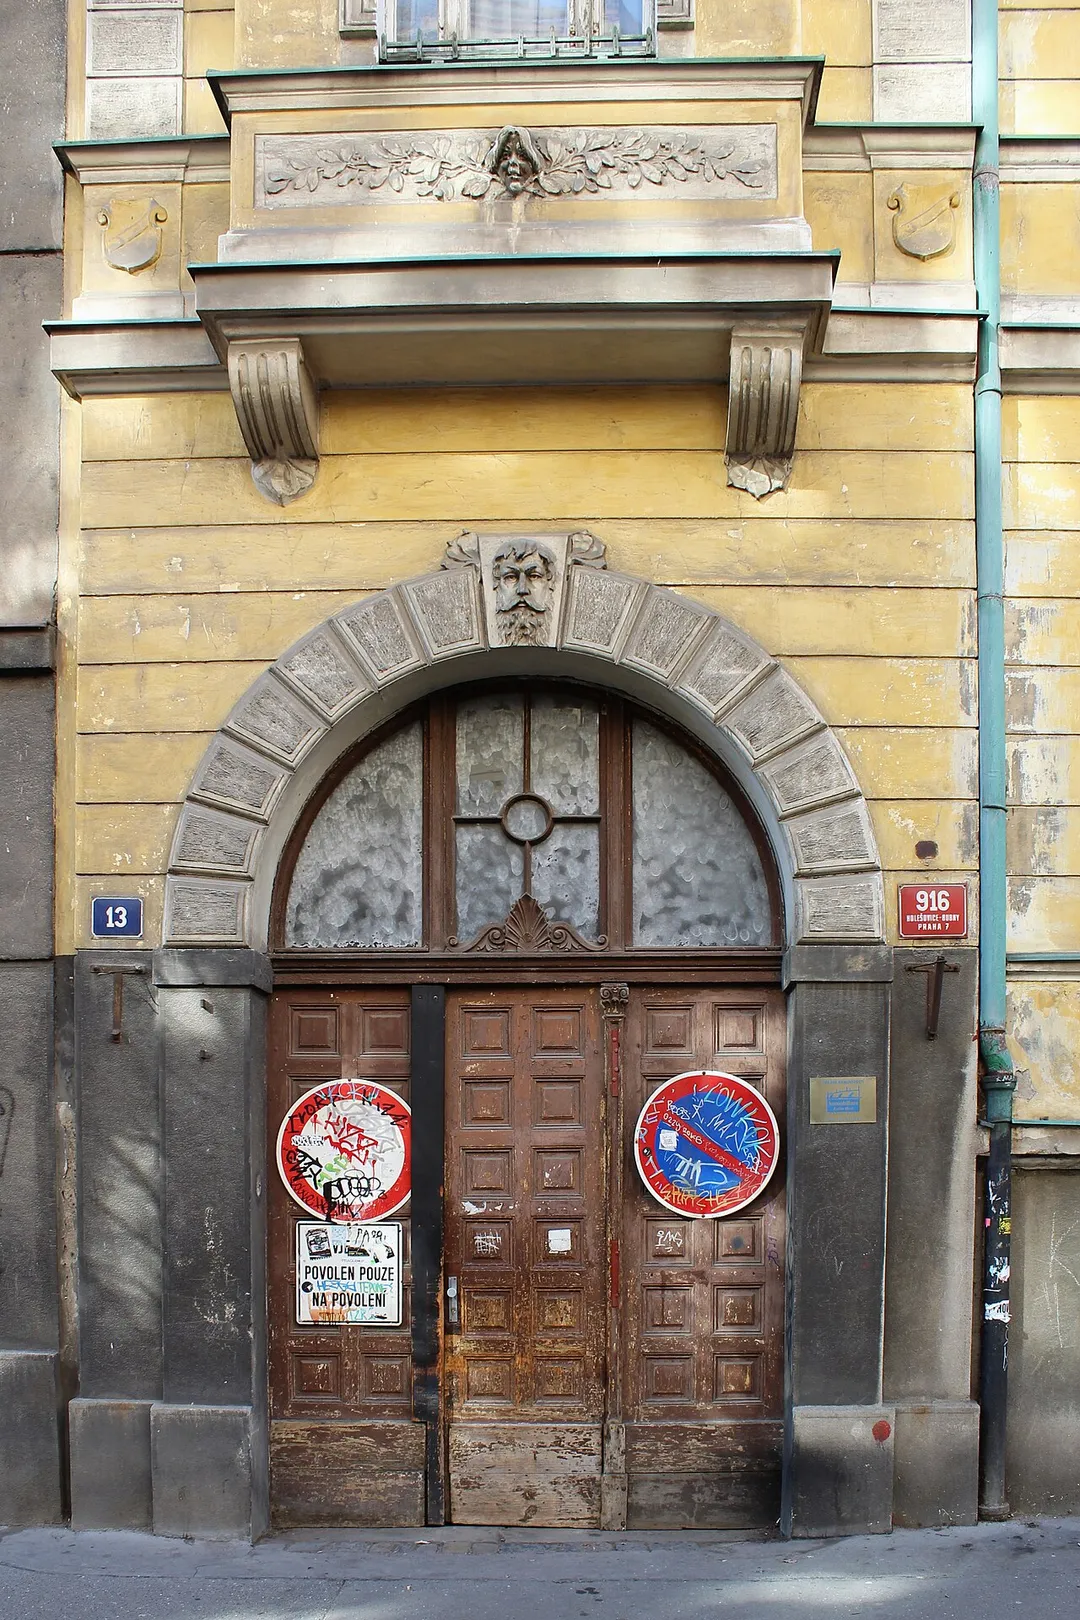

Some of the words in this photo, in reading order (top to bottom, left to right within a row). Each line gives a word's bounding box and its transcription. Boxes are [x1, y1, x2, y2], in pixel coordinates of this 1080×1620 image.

[916, 890, 950, 911] 916
[105, 906, 127, 928] 13
[304, 1265, 355, 1281] POVOLEN
[360, 1266, 394, 1282] POUZE
[312, 1292, 328, 1307] NA
[332, 1289, 386, 1308] POVOLENÍ
